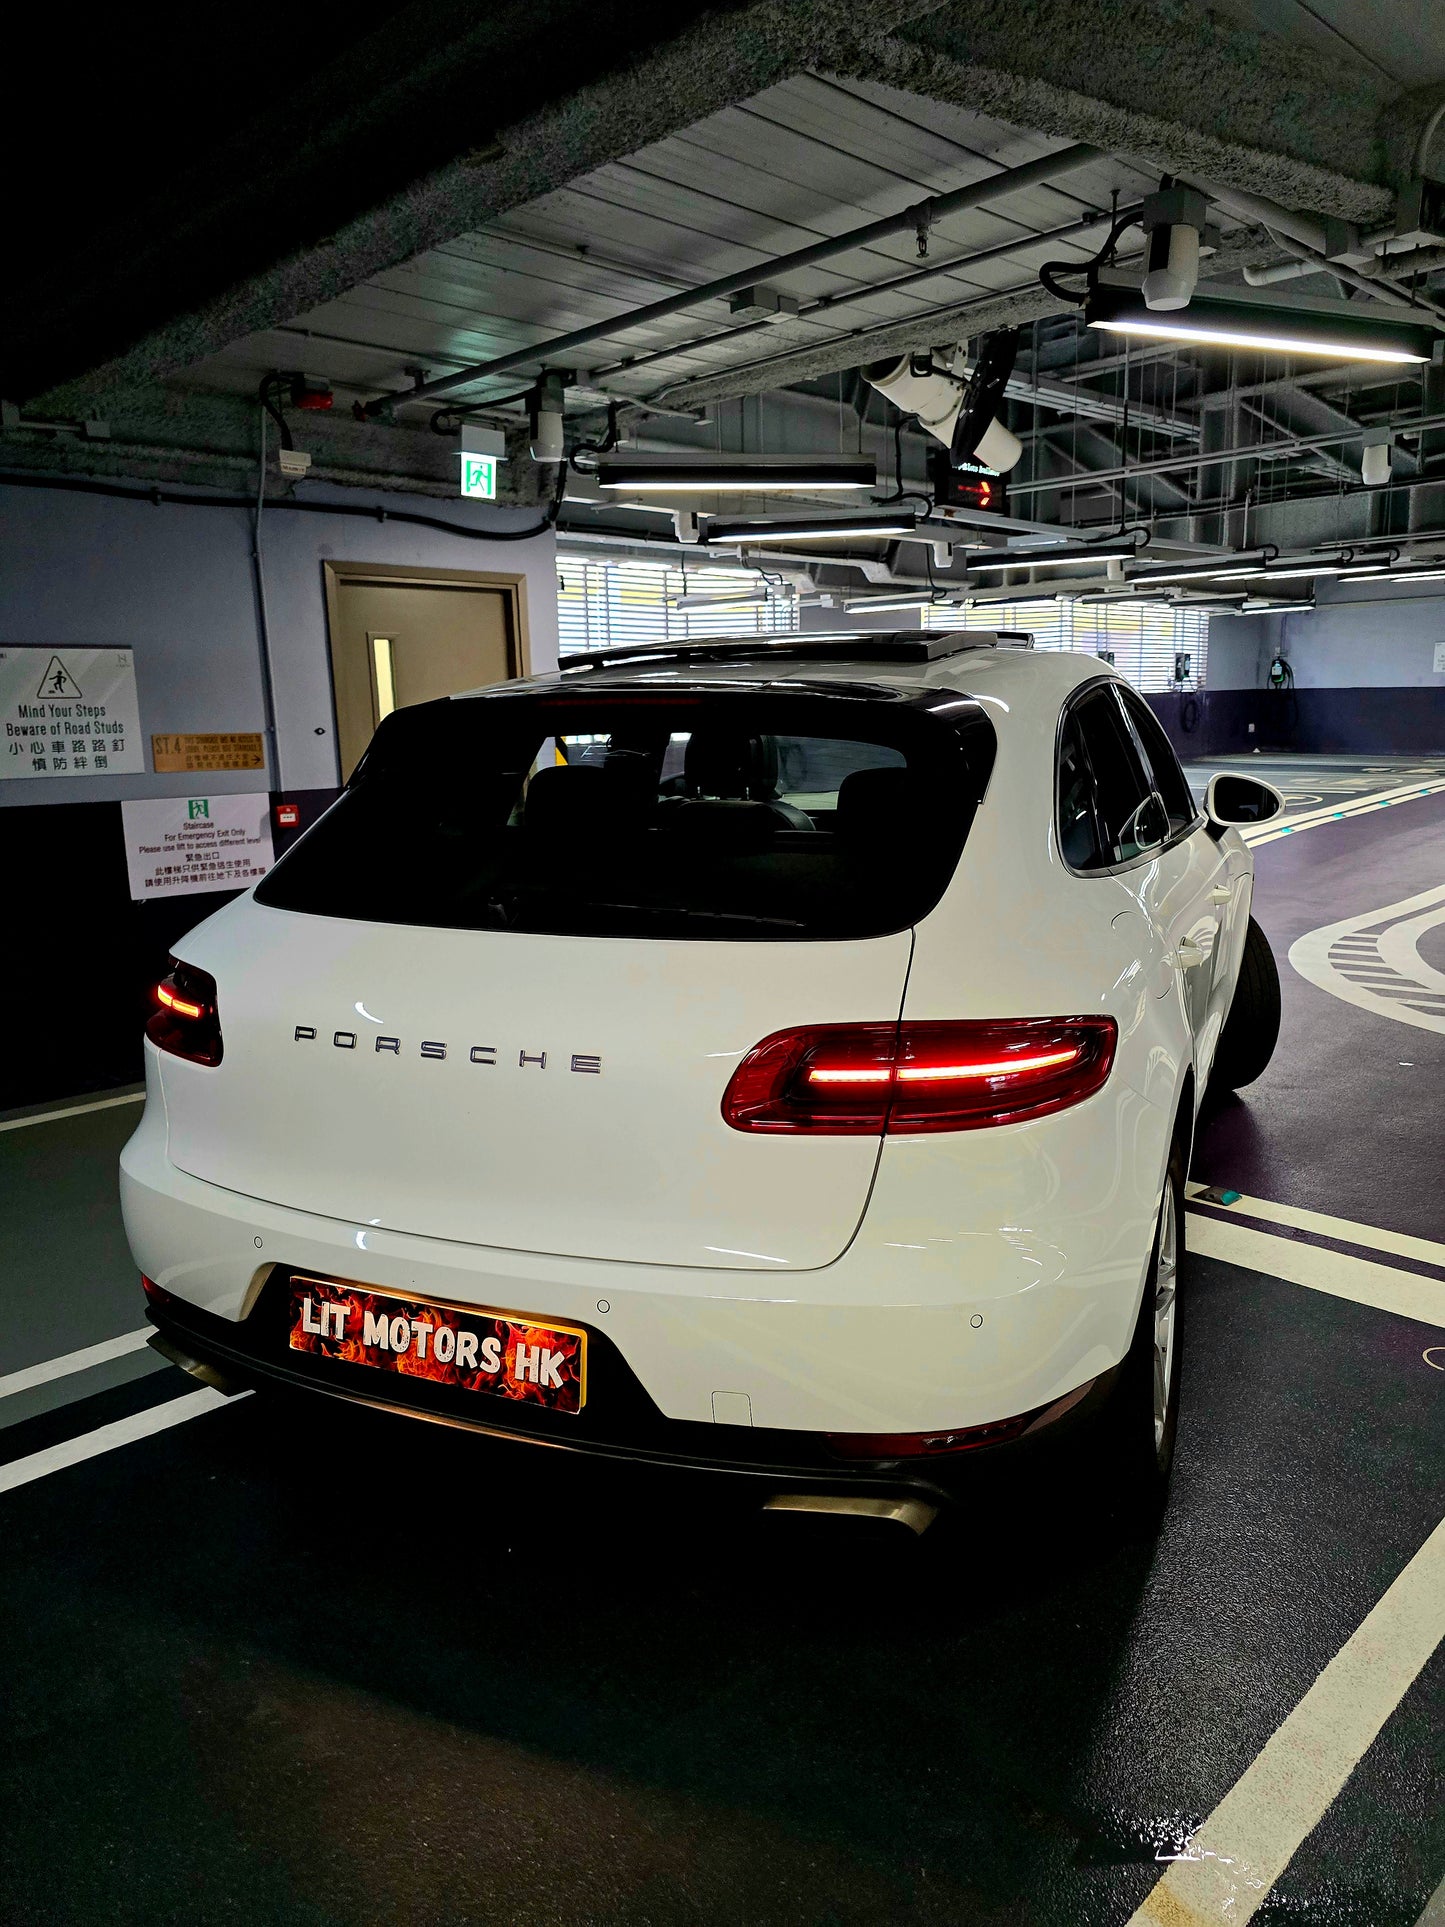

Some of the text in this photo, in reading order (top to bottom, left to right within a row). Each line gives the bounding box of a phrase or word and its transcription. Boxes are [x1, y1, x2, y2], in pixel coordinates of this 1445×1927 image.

[18, 703, 106, 719] Mind Your Steps
[6, 720, 124, 737] Beware of Road Studs
[9, 738, 125, 755] 小心車路路釘
[32, 755, 108, 771] 慎防絆倒
[183, 821, 214, 831] Staircase
[164, 828, 246, 842] For Emergency Exit Only
[139, 845, 161, 854] Please
[163, 844, 175, 852] use
[187, 842, 194, 850] to
[196, 841, 217, 849] access
[219, 838, 246, 847] different
[185, 851, 220, 862] 緊急出口
[295, 1025, 602, 1073] PORSCHE
[302, 1297, 565, 1389] LIT MOTORS HK
